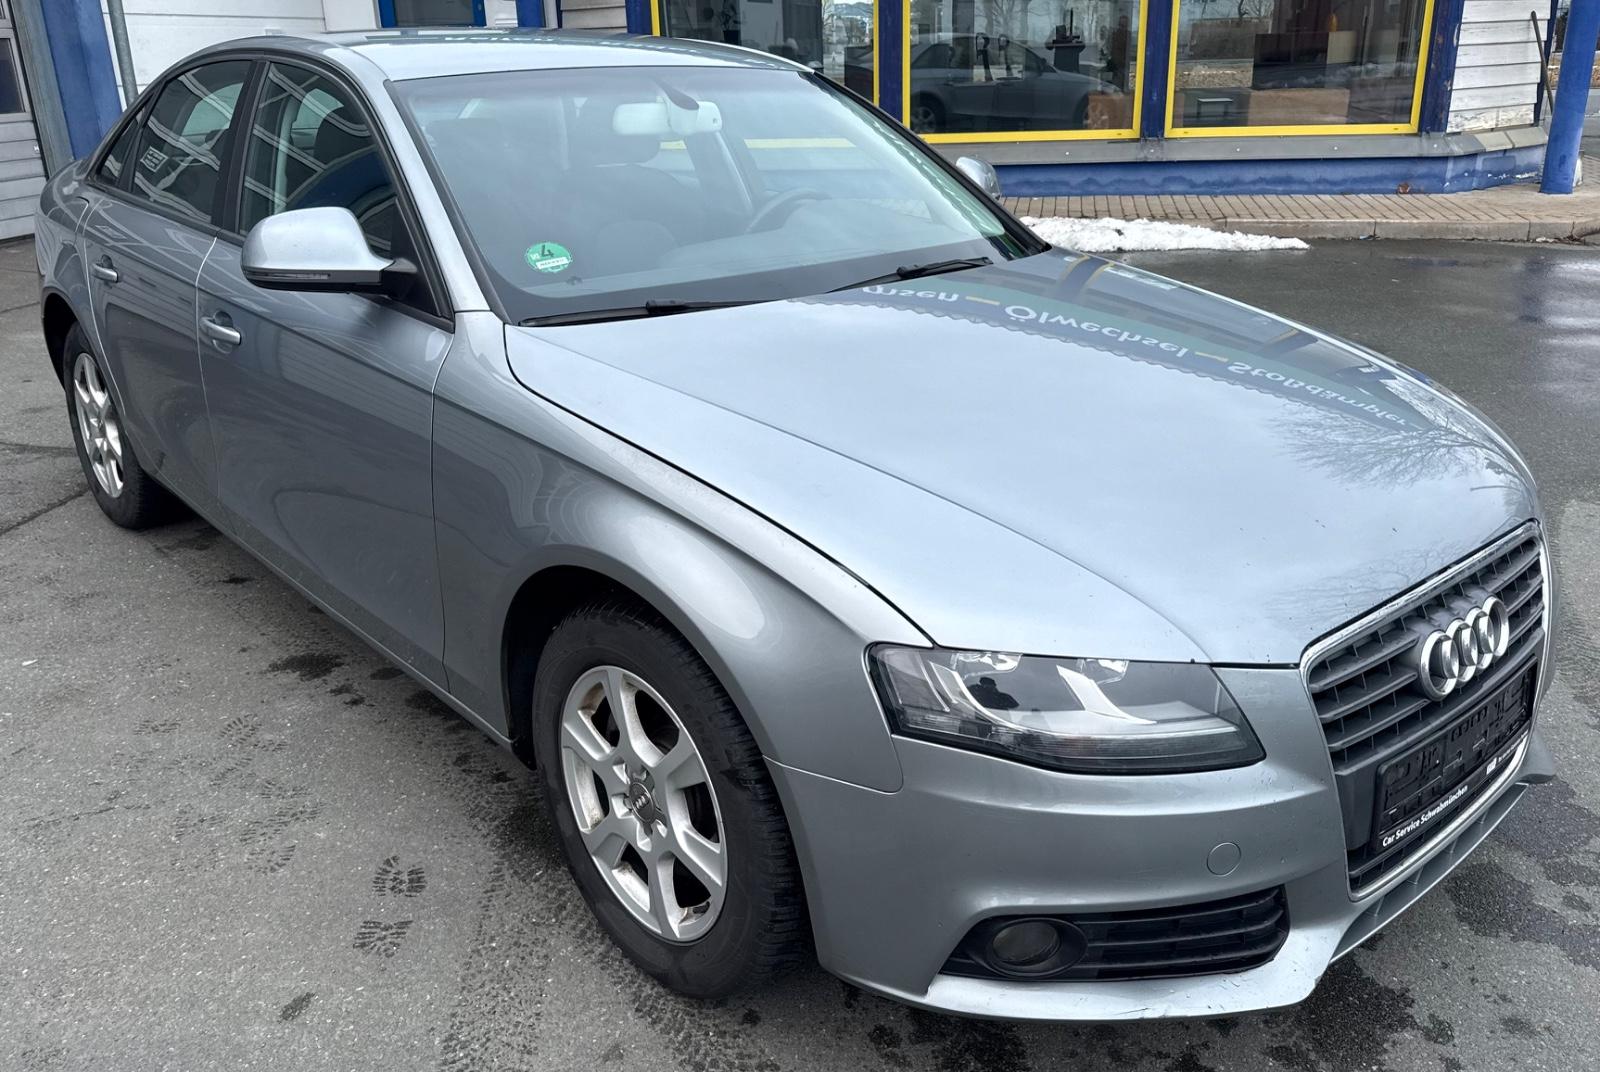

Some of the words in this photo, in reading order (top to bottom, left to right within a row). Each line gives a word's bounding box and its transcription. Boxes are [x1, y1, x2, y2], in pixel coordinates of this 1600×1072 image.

[541, 243, 555, 257] 4
[1382, 834, 1396, 847] Car
[1395, 819, 1421, 840] Service
